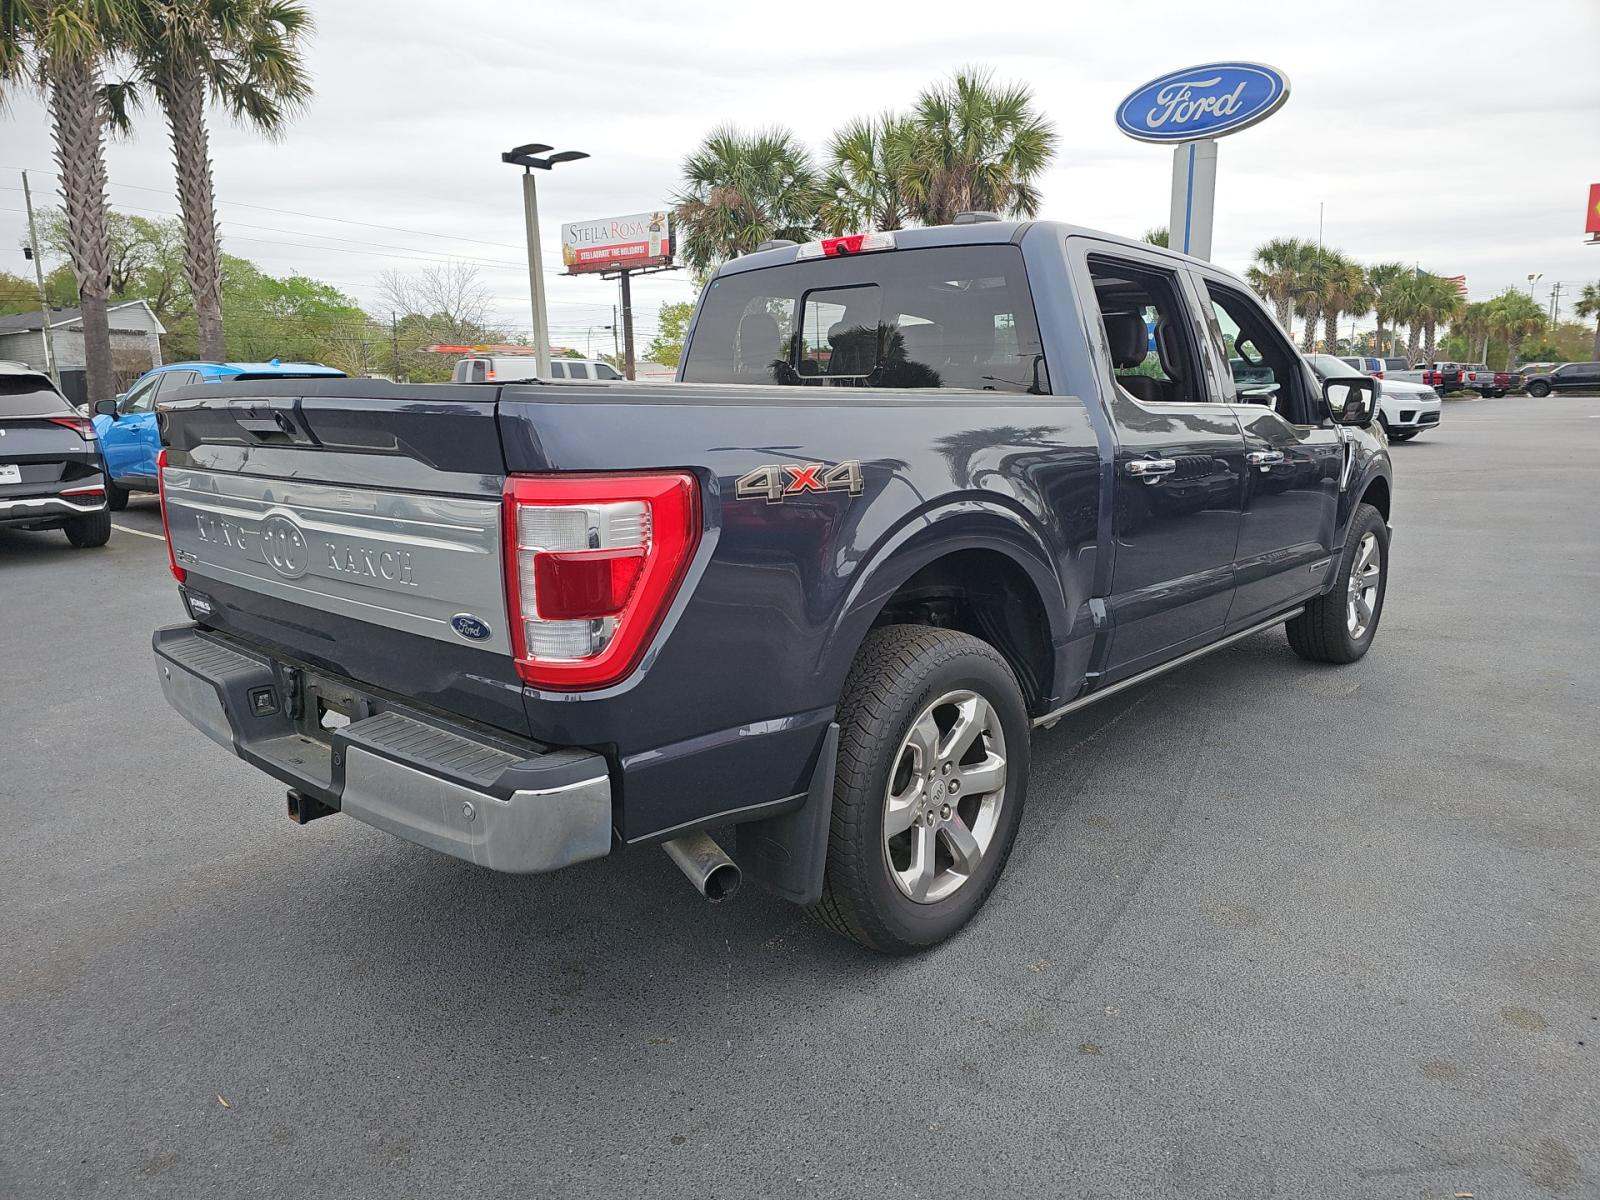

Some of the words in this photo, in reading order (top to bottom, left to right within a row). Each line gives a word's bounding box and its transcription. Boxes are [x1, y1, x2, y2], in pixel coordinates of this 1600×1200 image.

[1146, 77, 1248, 128] Ford
[569, 224, 609, 244] STELLA
[611, 220, 644, 240] ROSA
[195, 513, 248, 550] KING
[325, 541, 419, 587] RANCH
[458, 618, 481, 637] Ford
